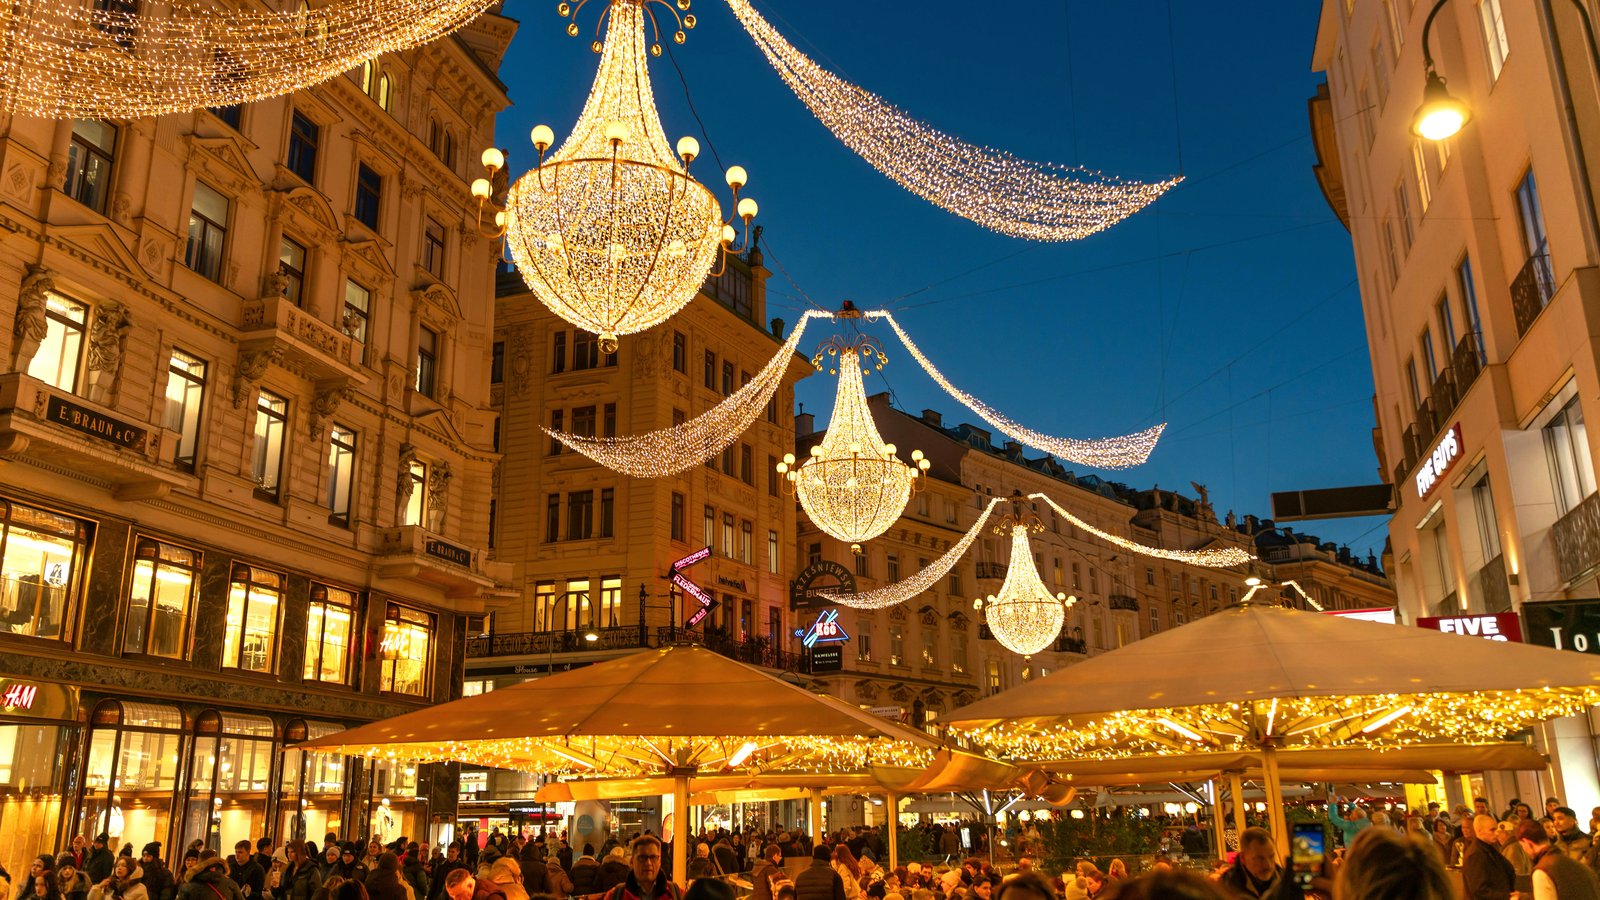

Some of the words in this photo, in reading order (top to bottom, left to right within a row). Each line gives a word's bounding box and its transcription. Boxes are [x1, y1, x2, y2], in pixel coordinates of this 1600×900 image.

[59, 405, 69, 420] E.
[74, 410, 113, 436] BRAUN
[115, 430, 121, 440] &
[1416, 457, 1435, 498] FIVE
[1432, 428, 1457, 476] GUYS
[674, 547, 710, 568] DISCOTHEQUE
[673, 575, 711, 606] FLEDERMAUS
[806, 587, 840, 598] BUFFET
[1439, 616, 1499, 636] FIVE
[4, 684, 37, 710] H&M
